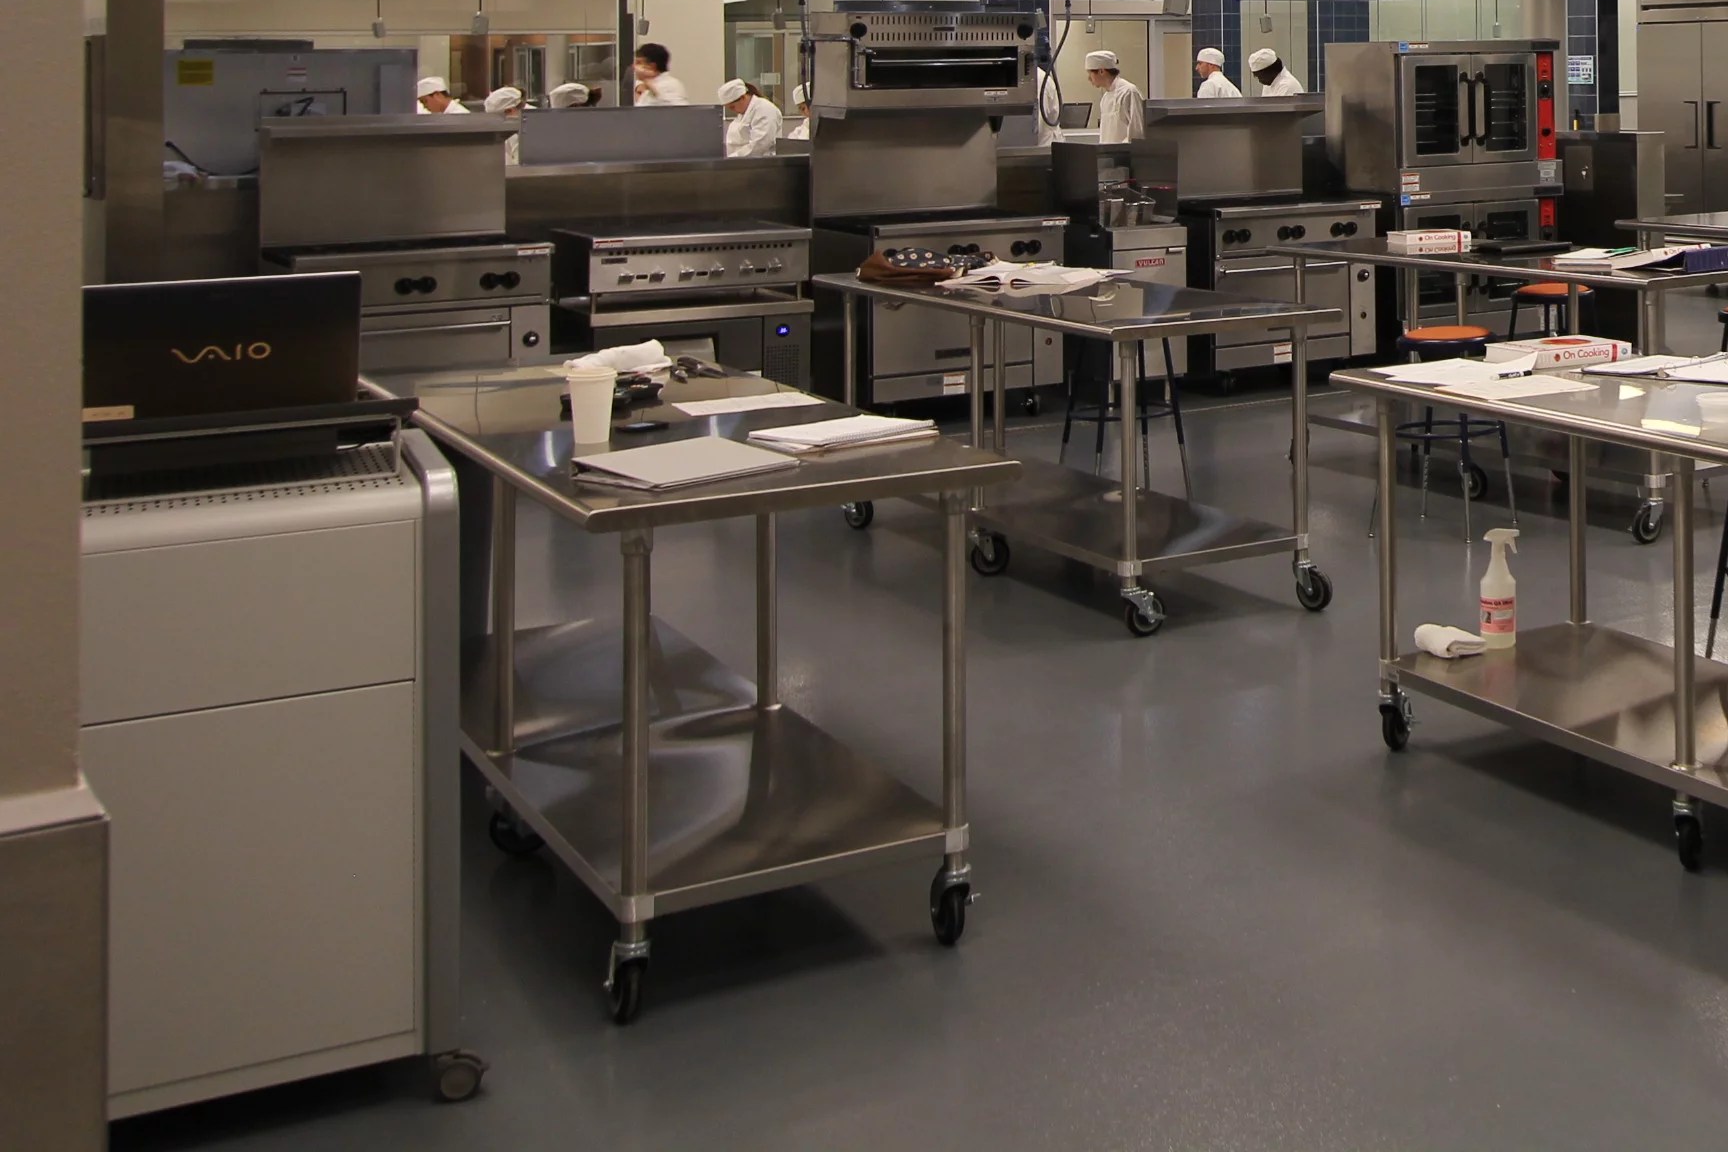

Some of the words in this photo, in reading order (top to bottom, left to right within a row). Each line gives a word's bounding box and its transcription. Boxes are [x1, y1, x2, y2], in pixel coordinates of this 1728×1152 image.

[1434, 234, 1457, 242] Cooking
[1138, 258, 1164, 267] VULCAN
[171, 342, 271, 364] VAIO
[1563, 350, 1576, 360] On
[1577, 347, 1610, 360] Cooking
